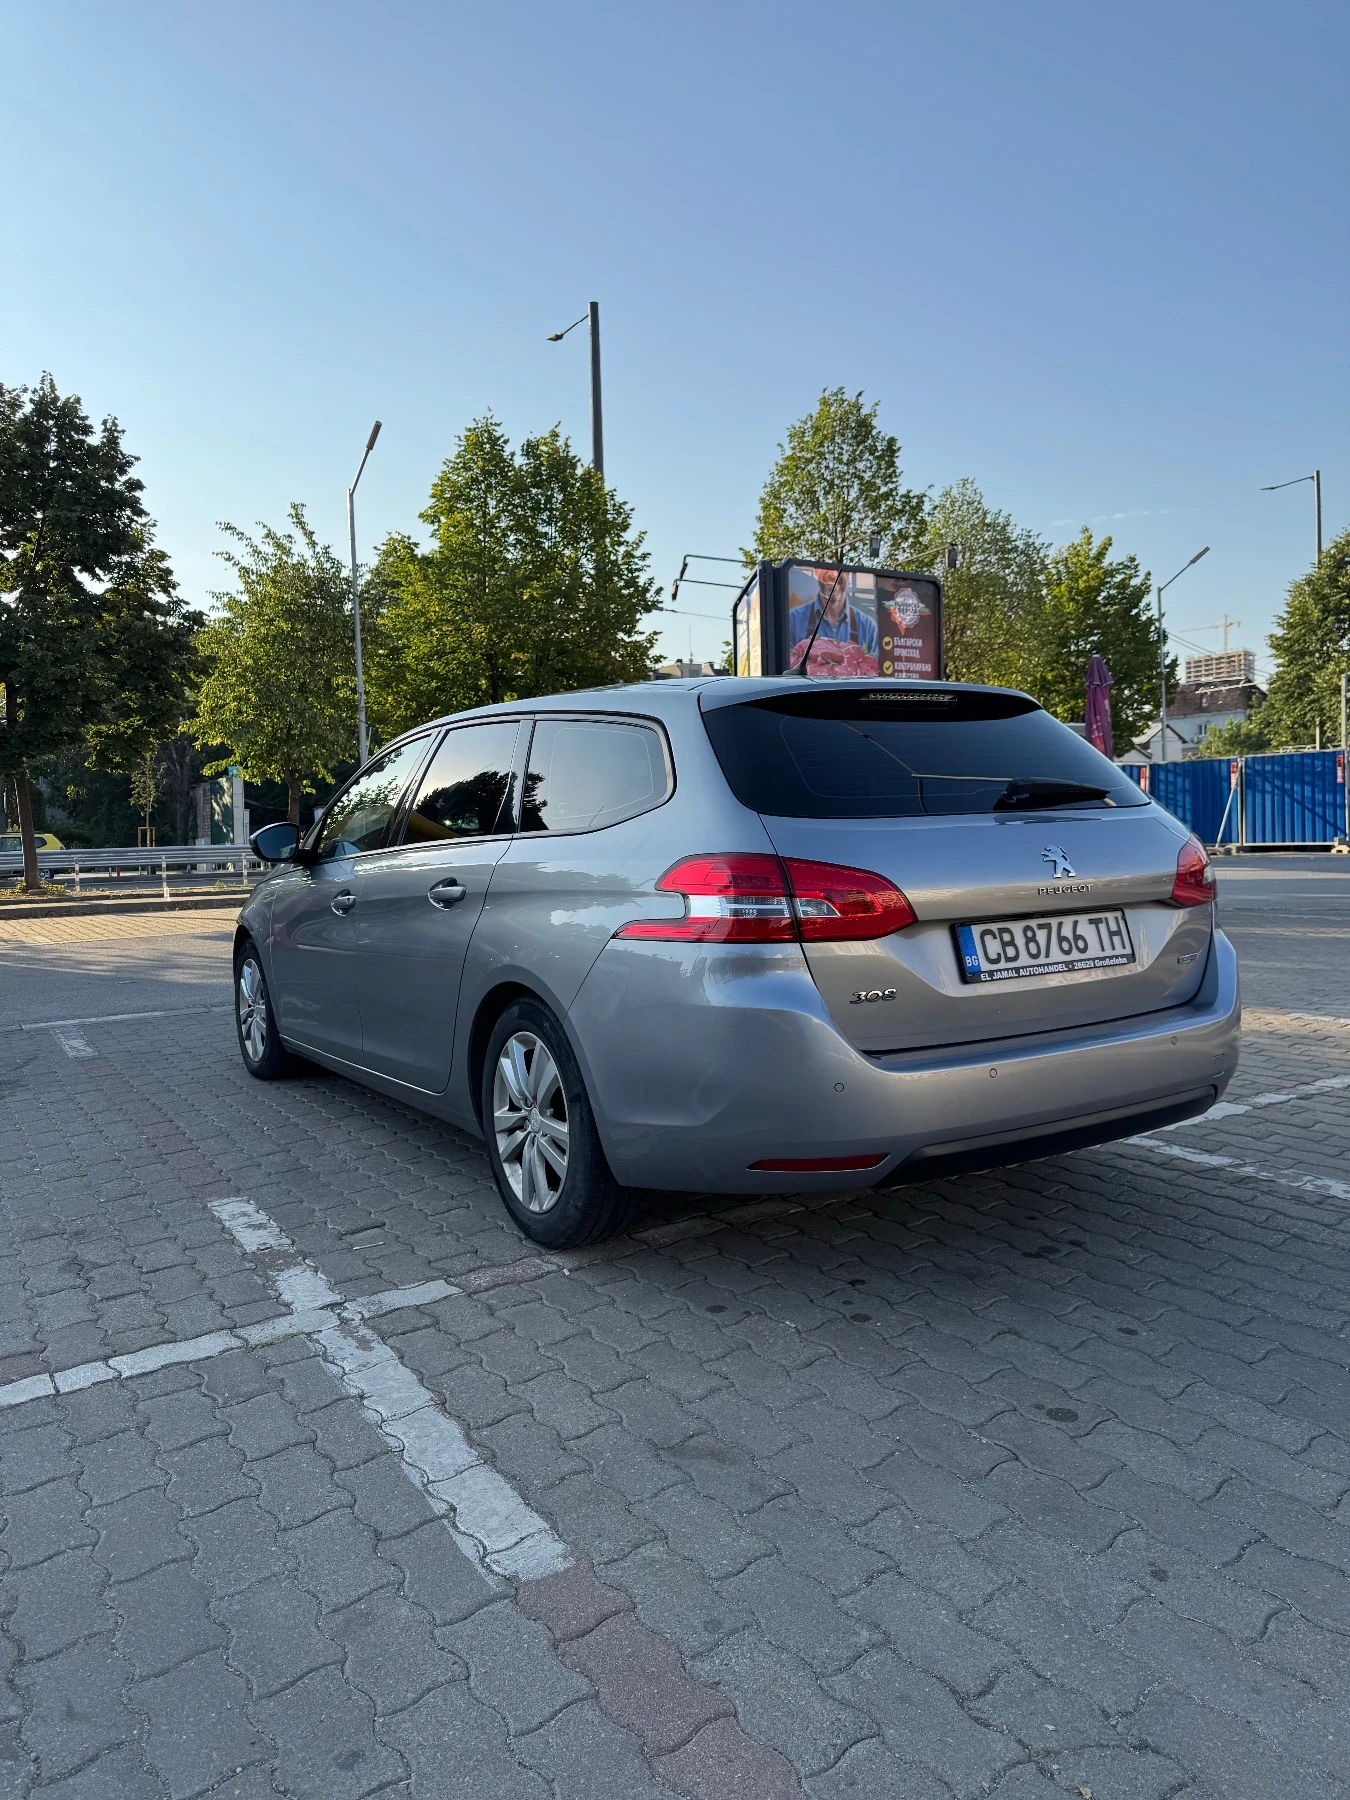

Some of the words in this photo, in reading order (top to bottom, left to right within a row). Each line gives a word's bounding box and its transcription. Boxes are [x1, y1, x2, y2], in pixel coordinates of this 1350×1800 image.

[1038, 883, 1094, 895] PEUGEOT
[980, 927, 1020, 965] CB
[1023, 919, 1089, 960] 8766
[1088, 916, 1127, 953] TH
[965, 955, 979, 967] BG
[980, 973, 992, 981] EL
[992, 969, 1018, 980] JAMAL
[1019, 963, 1069, 977] AUTOHANDEL
[1073, 959, 1094, 970] 26629
[849, 987, 898, 1005] 308
